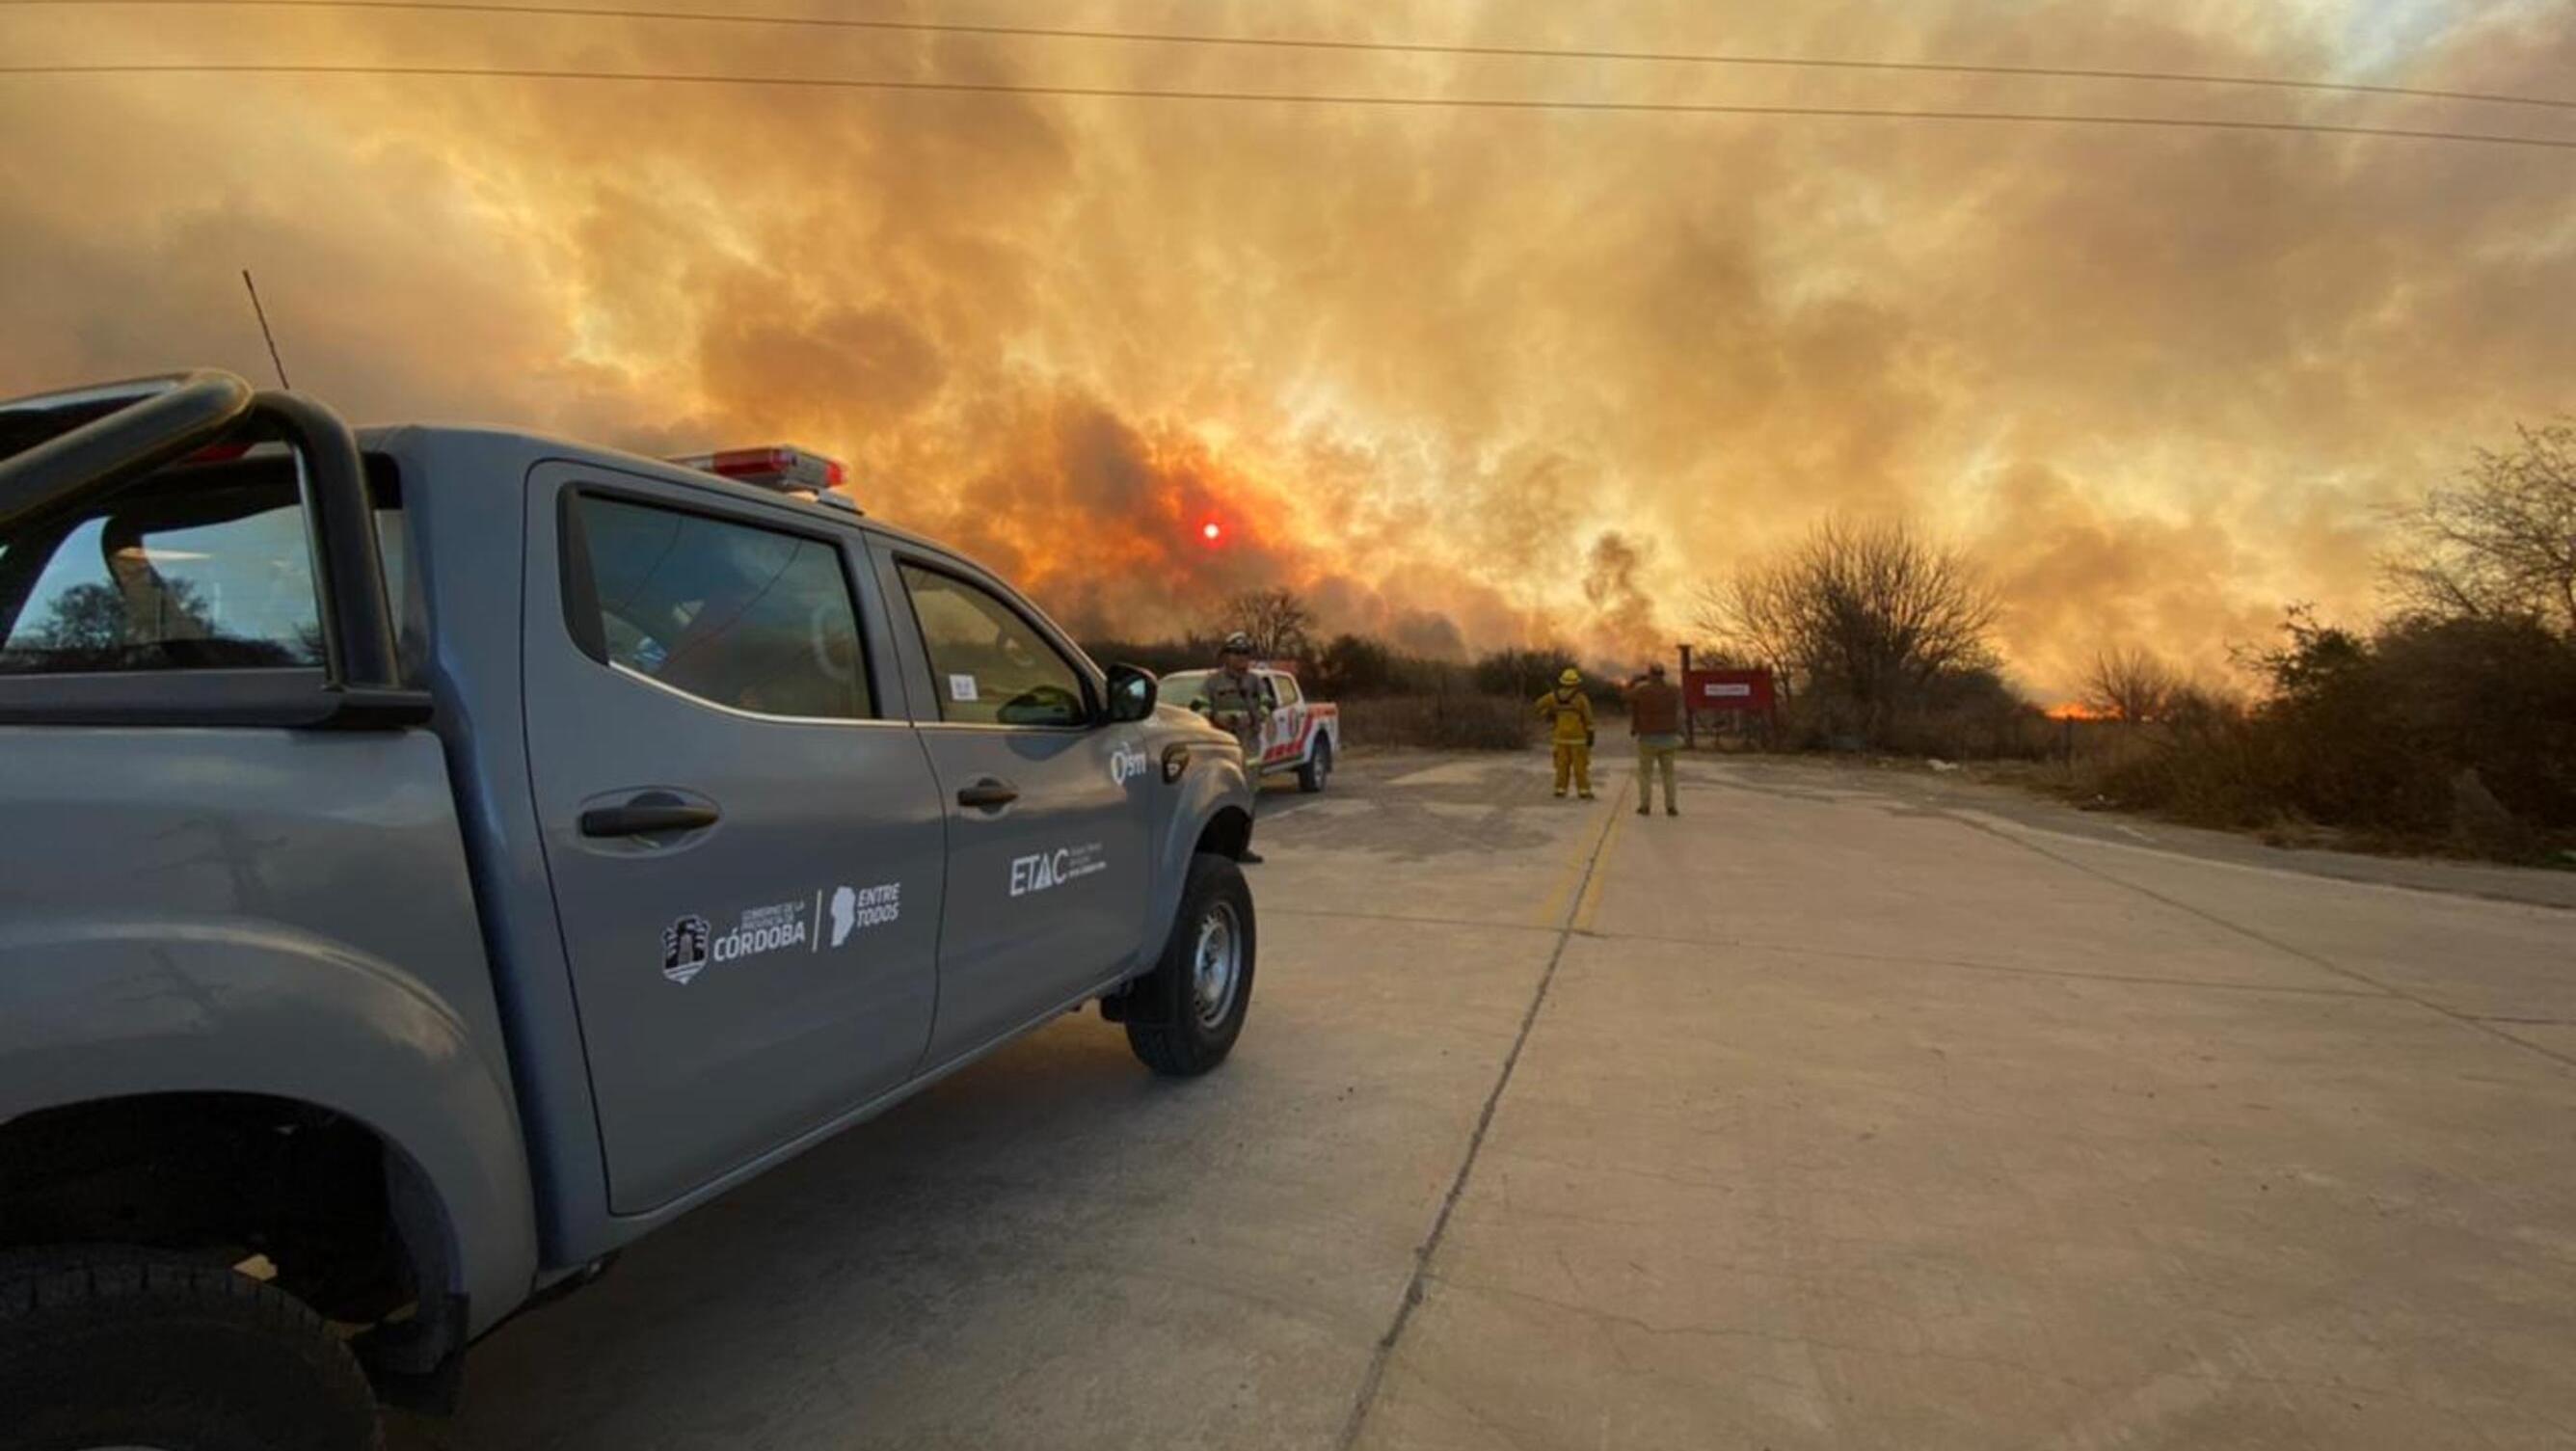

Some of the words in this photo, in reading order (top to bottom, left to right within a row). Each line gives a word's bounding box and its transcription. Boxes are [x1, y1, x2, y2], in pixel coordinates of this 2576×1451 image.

[1010, 847, 1069, 897] ETAC
[857, 882, 901, 908] ENTRE
[856, 902, 900, 928] TODOS
[713, 922, 806, 962] CÓRDOBA
